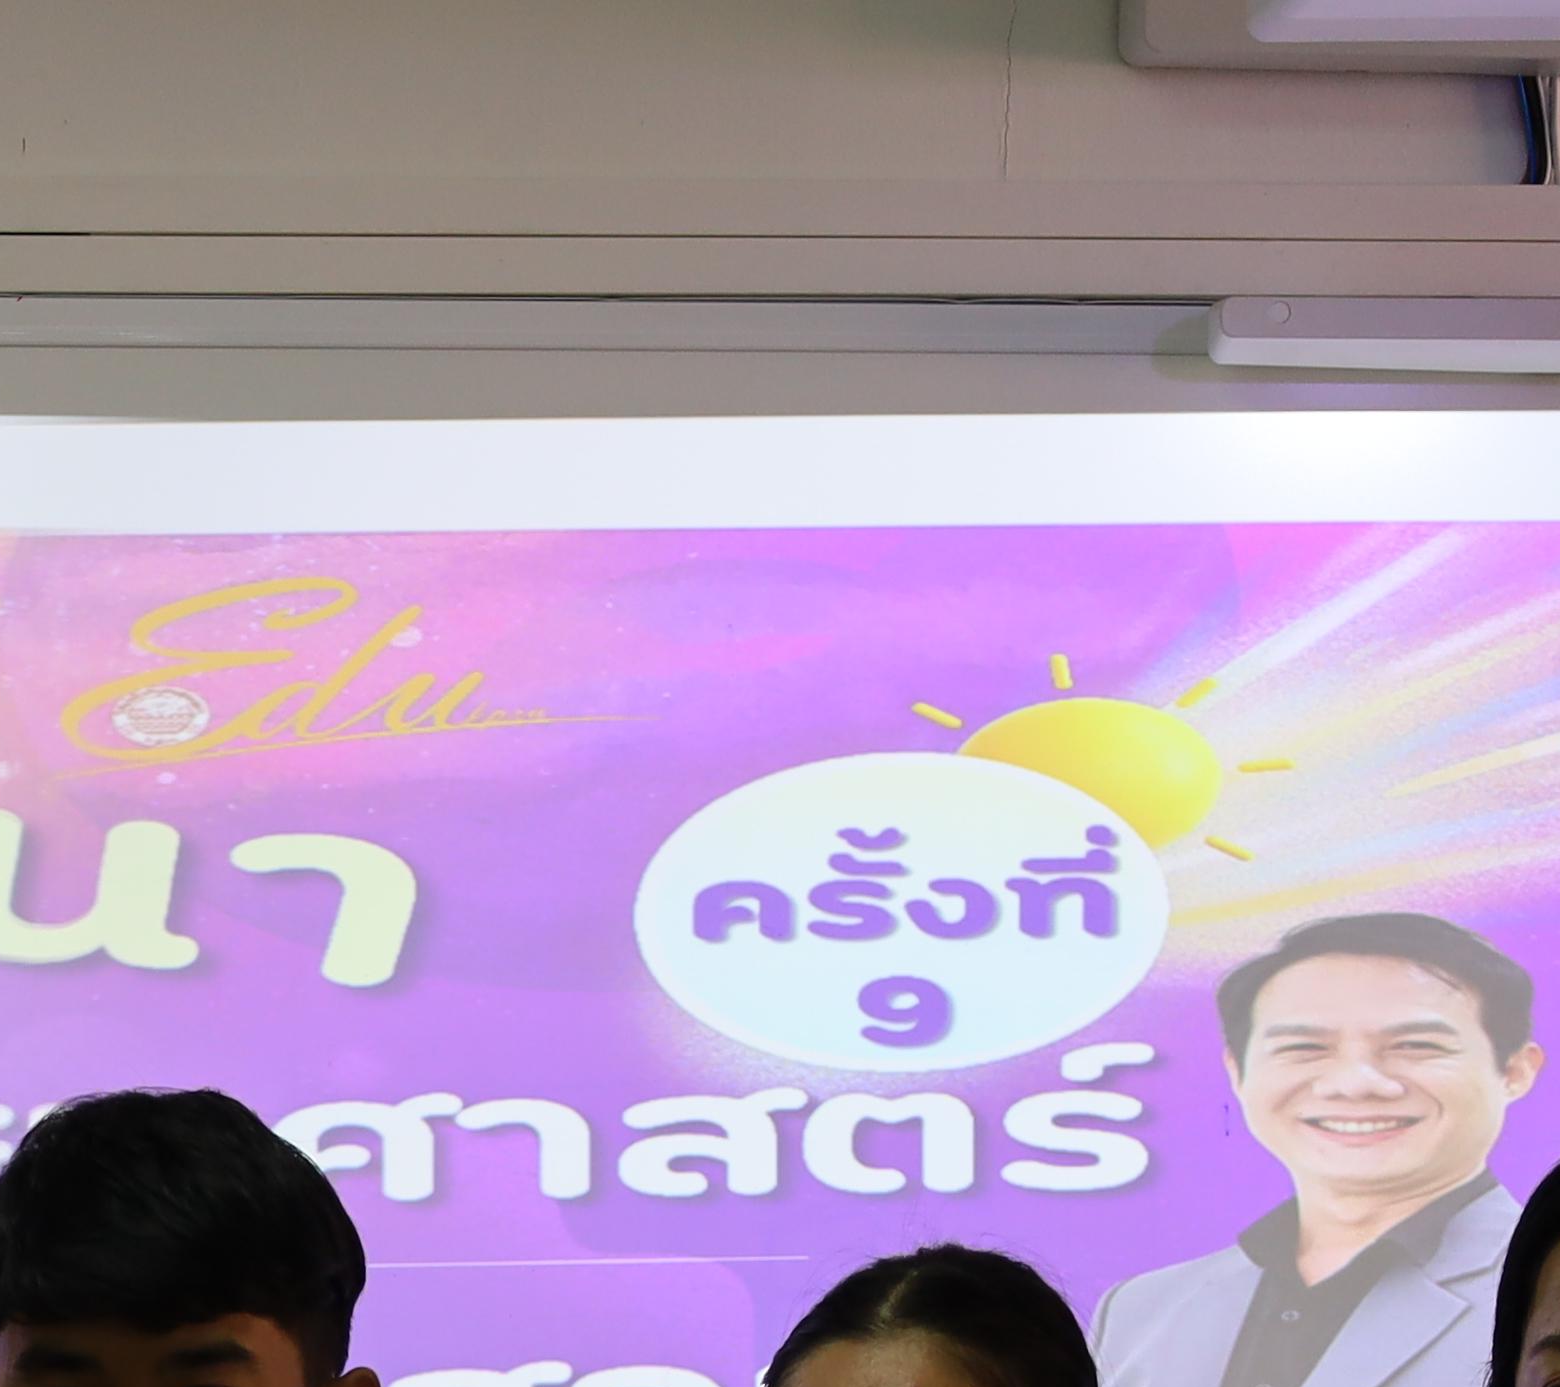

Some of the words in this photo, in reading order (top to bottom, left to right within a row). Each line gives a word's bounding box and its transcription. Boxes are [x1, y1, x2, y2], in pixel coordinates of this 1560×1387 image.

[60, 576, 482, 760] Edu
[693, 824, 1118, 941] ครั้งที่
[857, 975, 953, 1048] 9
